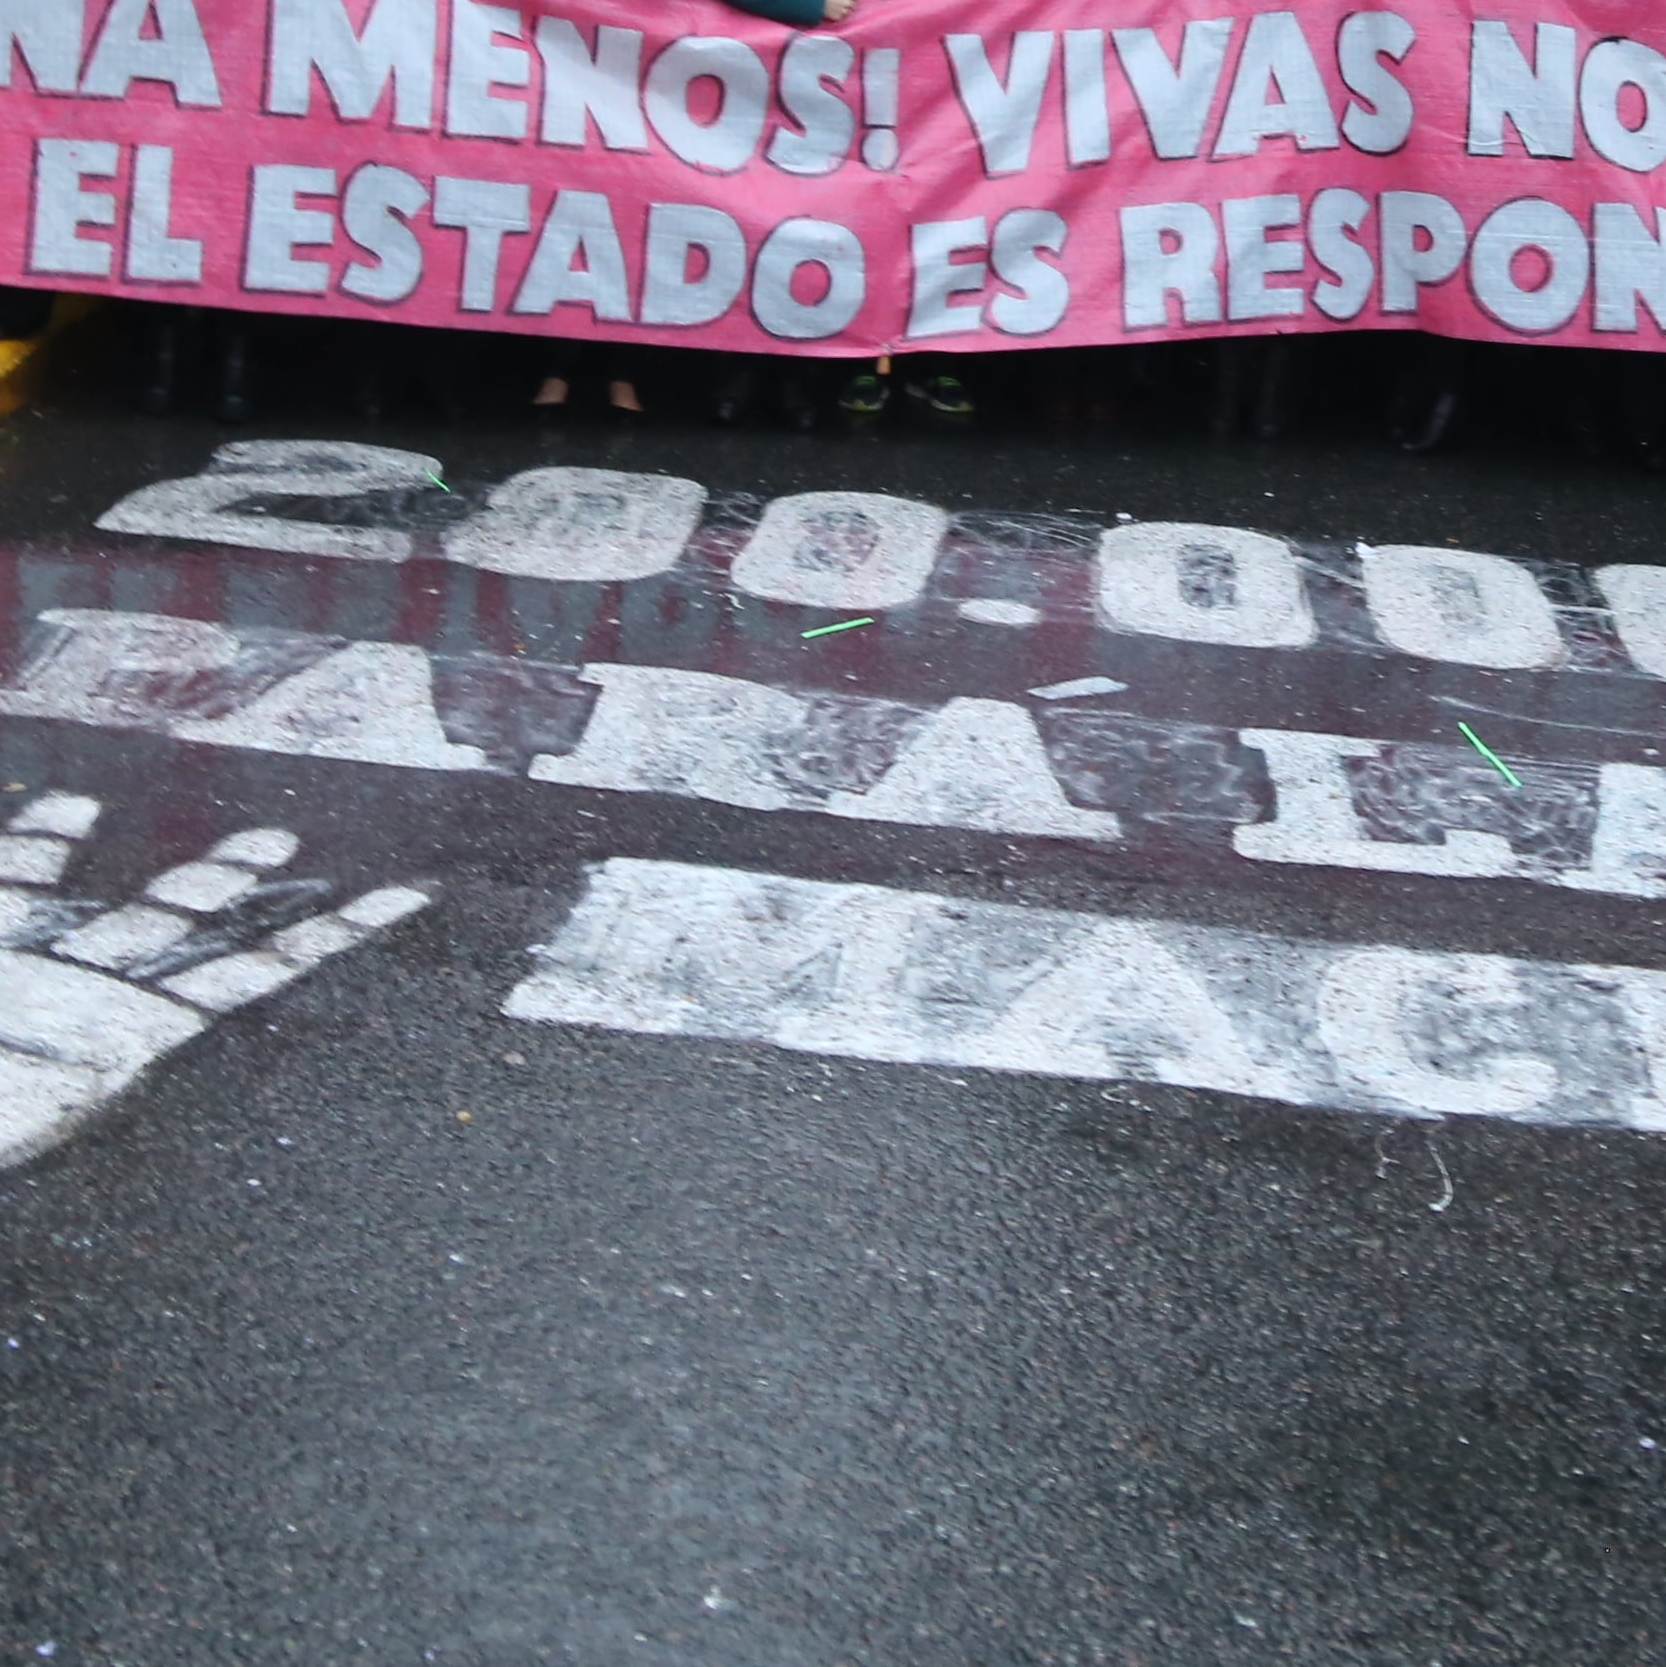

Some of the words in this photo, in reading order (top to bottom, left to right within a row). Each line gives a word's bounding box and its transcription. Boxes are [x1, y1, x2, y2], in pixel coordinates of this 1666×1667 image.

[945, 10, 1415, 174] VIVAS
[30, 138, 203, 282] EL
[244, 163, 867, 341] ESTADO
[906, 209, 1070, 339] ES
